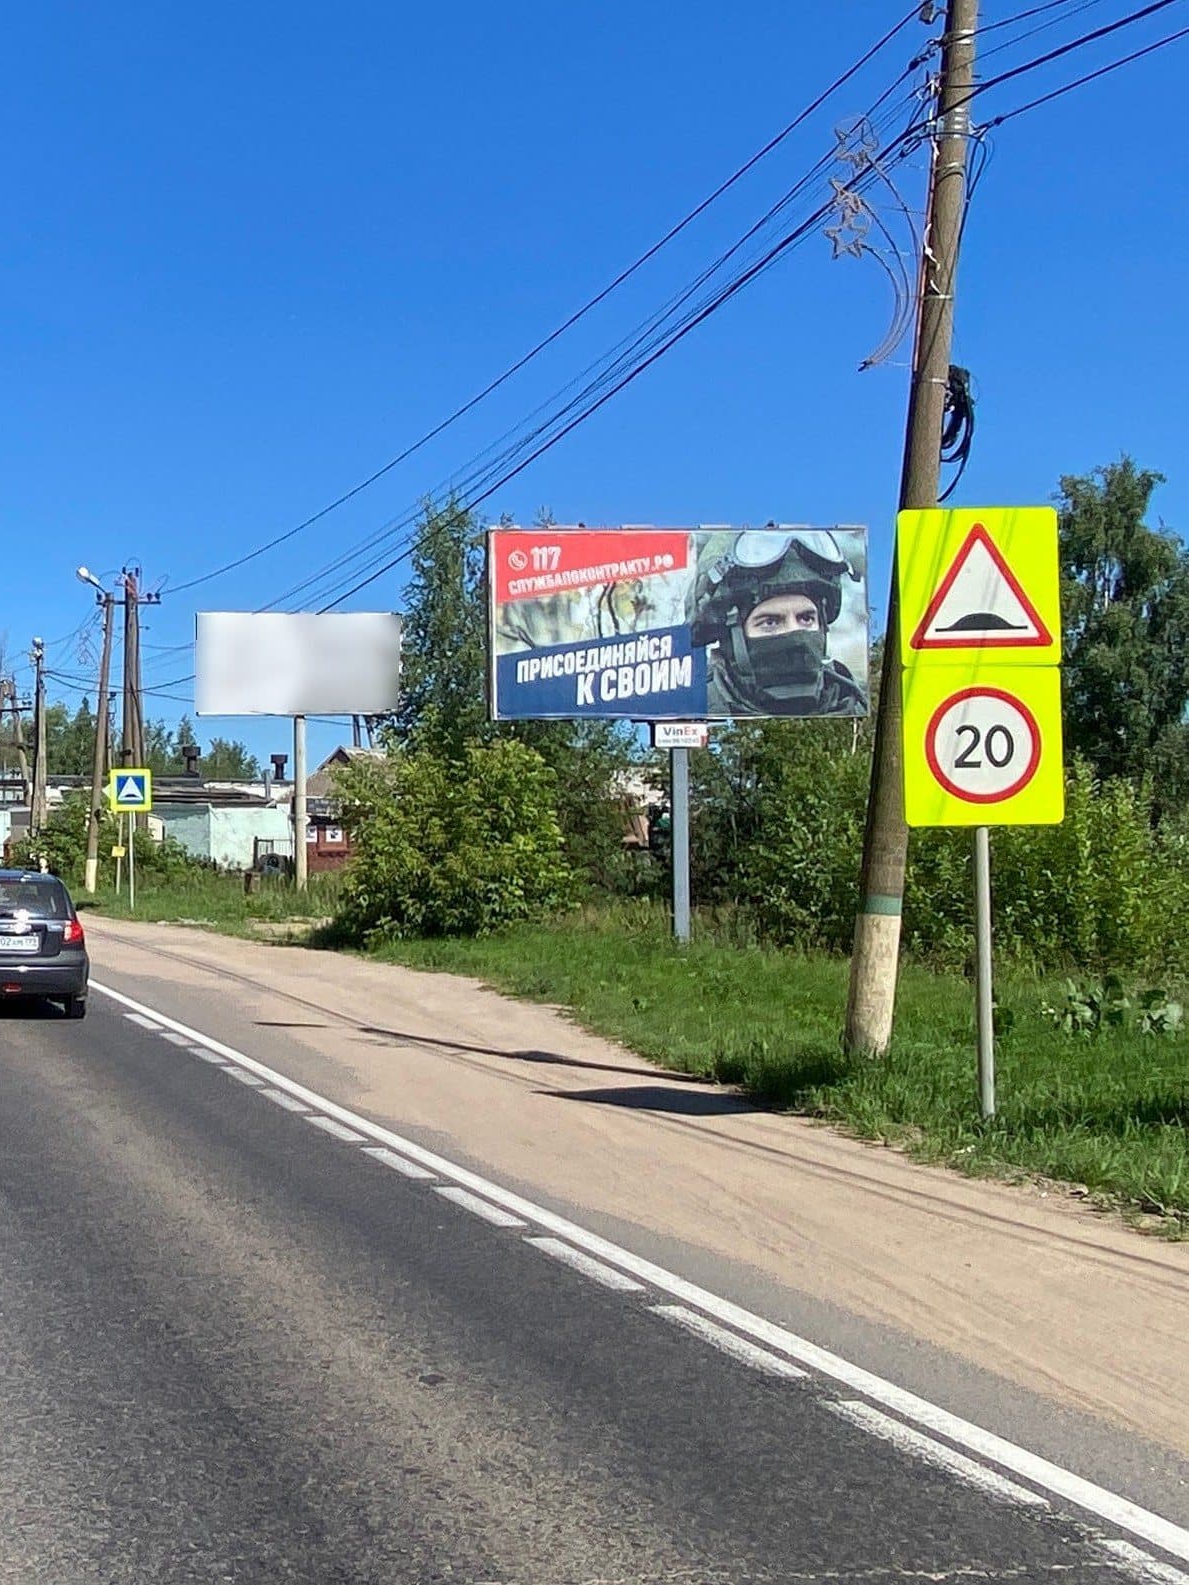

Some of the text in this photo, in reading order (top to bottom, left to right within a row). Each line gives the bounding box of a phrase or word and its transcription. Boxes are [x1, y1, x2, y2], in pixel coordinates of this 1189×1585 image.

[530, 546, 562, 571] 117
[516, 634, 673, 684] ПРИСОЕДИНЯЙСЯ
[576, 655, 693, 706] К СВОИМ
[954, 724, 1015, 769] 20
